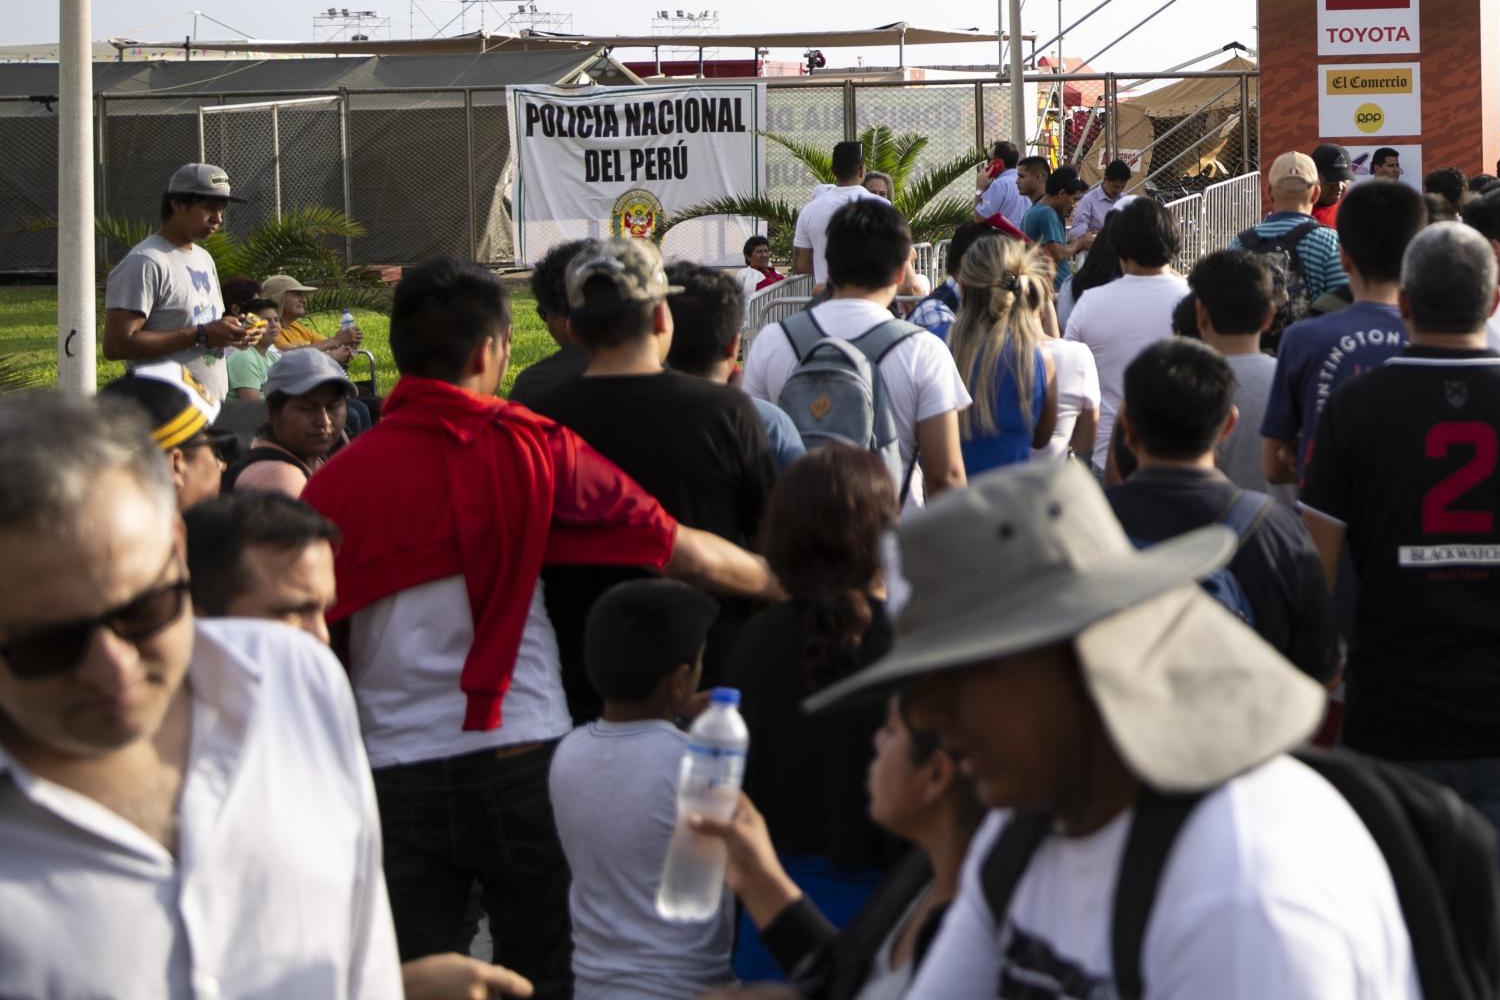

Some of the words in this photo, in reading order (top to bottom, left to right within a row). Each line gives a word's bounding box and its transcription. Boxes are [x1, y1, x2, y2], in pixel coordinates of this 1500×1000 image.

[1326, 26, 1411, 43] TOYOTA
[1332, 76, 1347, 89] El
[1350, 75, 1407, 89] Comercio
[525, 102, 619, 138] POLICIA
[625, 97, 746, 137] NACIONAL
[584, 148, 625, 183] DEL
[631, 140, 688, 182] PERÚ
[1421, 420, 1499, 534] 2
